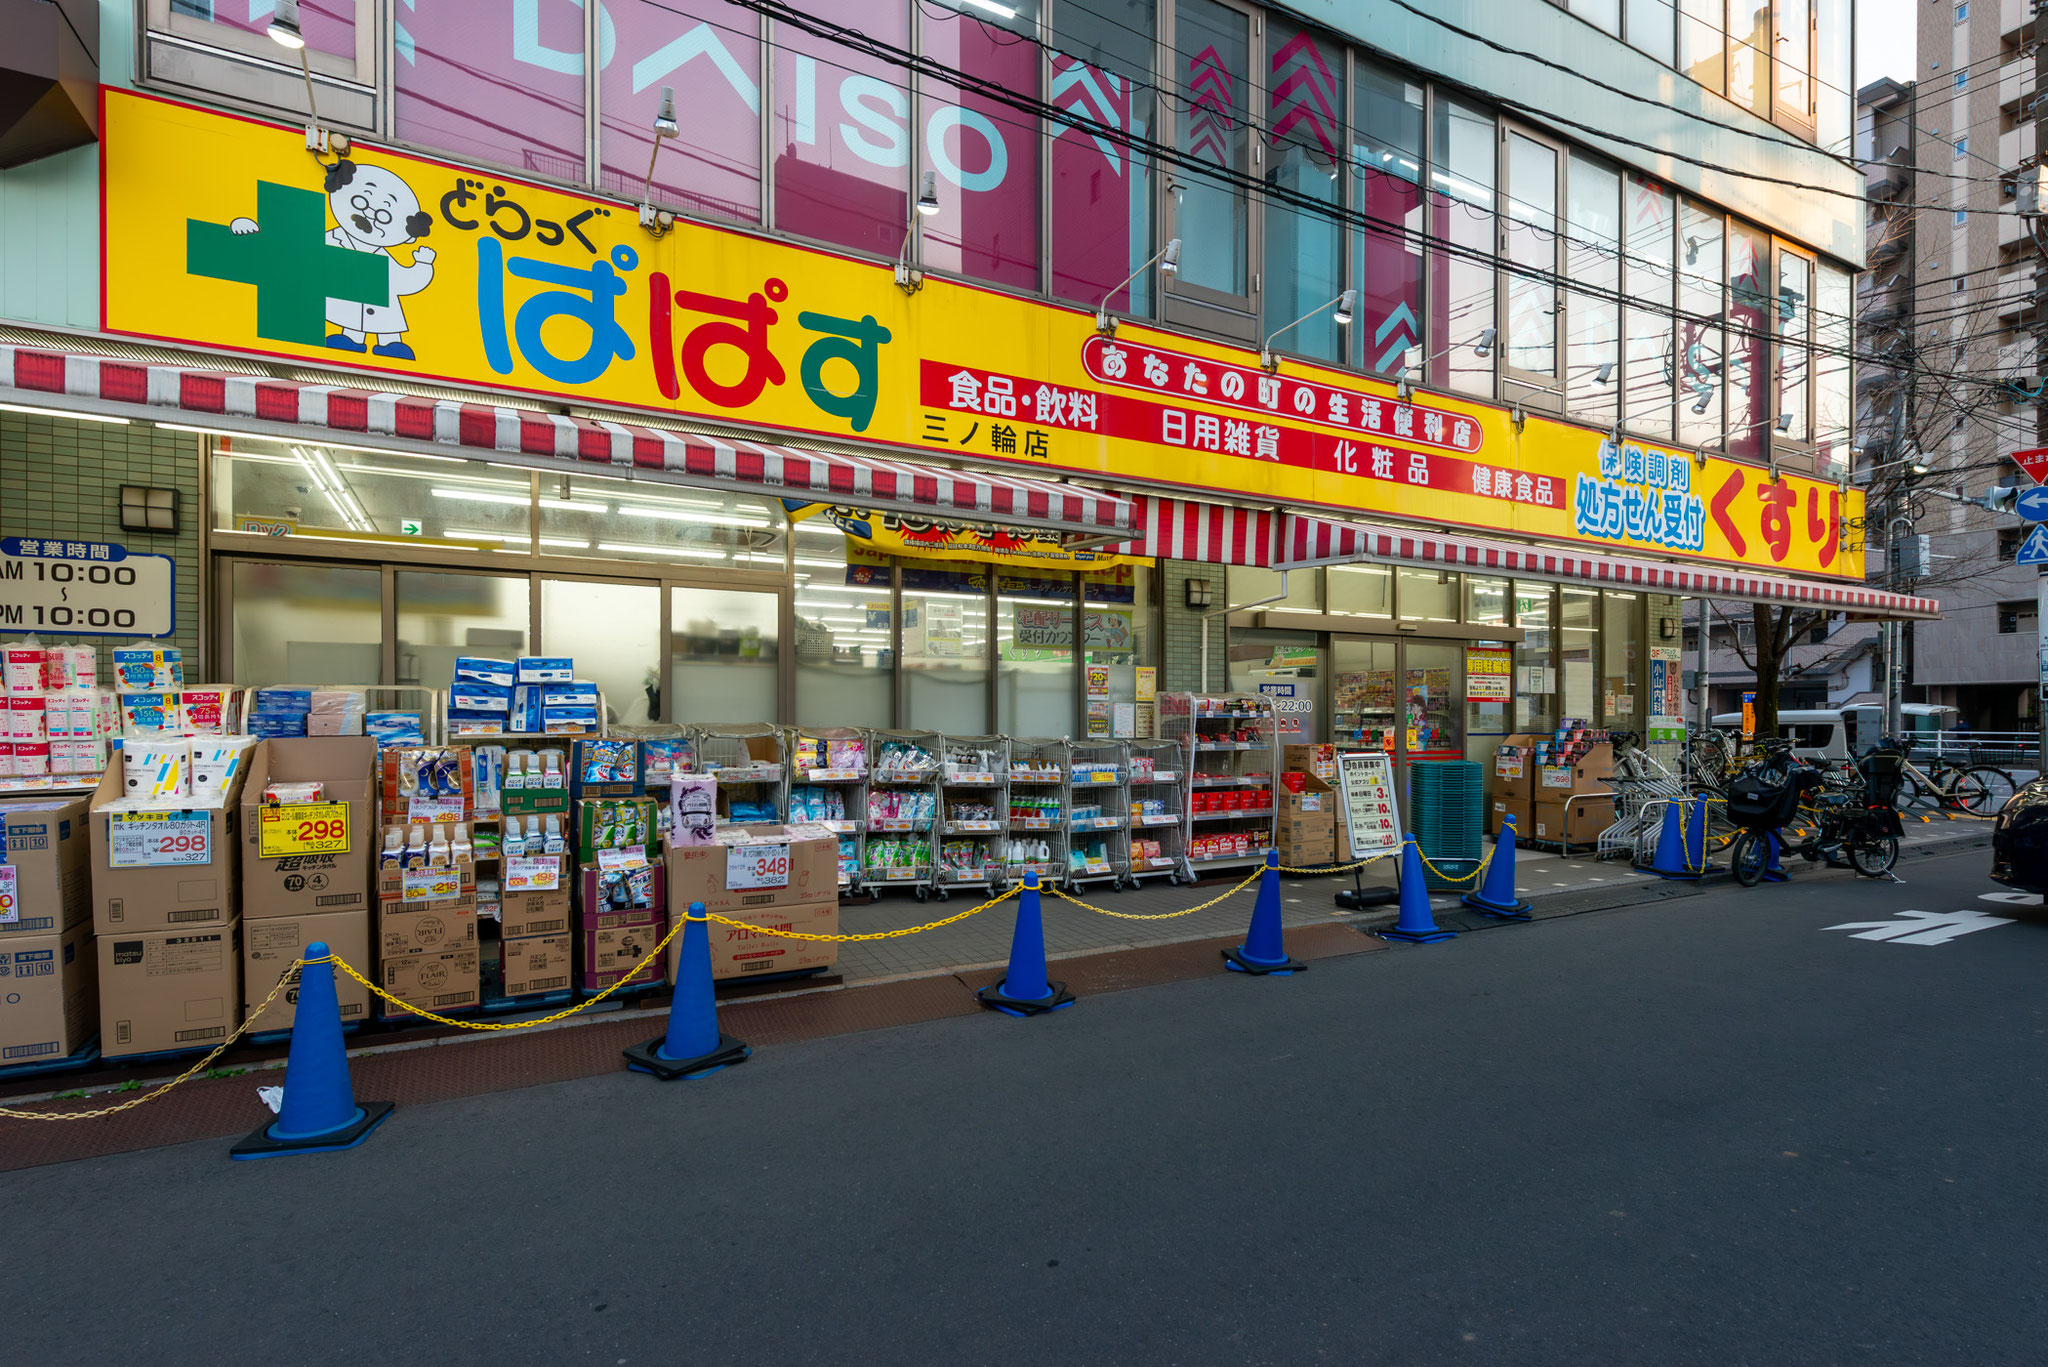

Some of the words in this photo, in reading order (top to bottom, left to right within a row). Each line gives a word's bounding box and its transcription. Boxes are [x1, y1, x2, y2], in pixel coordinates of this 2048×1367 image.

[513, 0, 1009, 192] DAISO
[440, 178, 611, 254] どらっぐ
[477, 243, 892, 432] ぱぱす
[1102, 345, 1472, 448] あなたの町の生活便利店
[922, 414, 1049, 459] 三ノ輪店
[947, 370, 1099, 431] 食品・飲料
[1162, 409, 1280, 461] 日用雑貨
[1334, 440, 1429, 485] 化粧品
[1472, 464, 1553, 506] 健康食品
[1599, 440, 1691, 493] 保険調剤
[1575, 473, 1705, 551] 処方せん受付
[1710, 468, 1839, 569] くすり
[19, 540, 110, 560] 営業時間
[33, 561, 136, 586] 10:00
[33, 605, 135, 628] 10:00
[192, 694, 219, 702] スコッティ
[1654, 663, 1662, 714] 小山内科
[1352, 761, 1381, 770] 会員募集中
[32, 838, 44, 846] 10
[288, 877, 302, 887] 70
[38, 963, 51, 972] 10
[115, 950, 143, 958] matsu
[115, 956, 132, 966] kiyo
